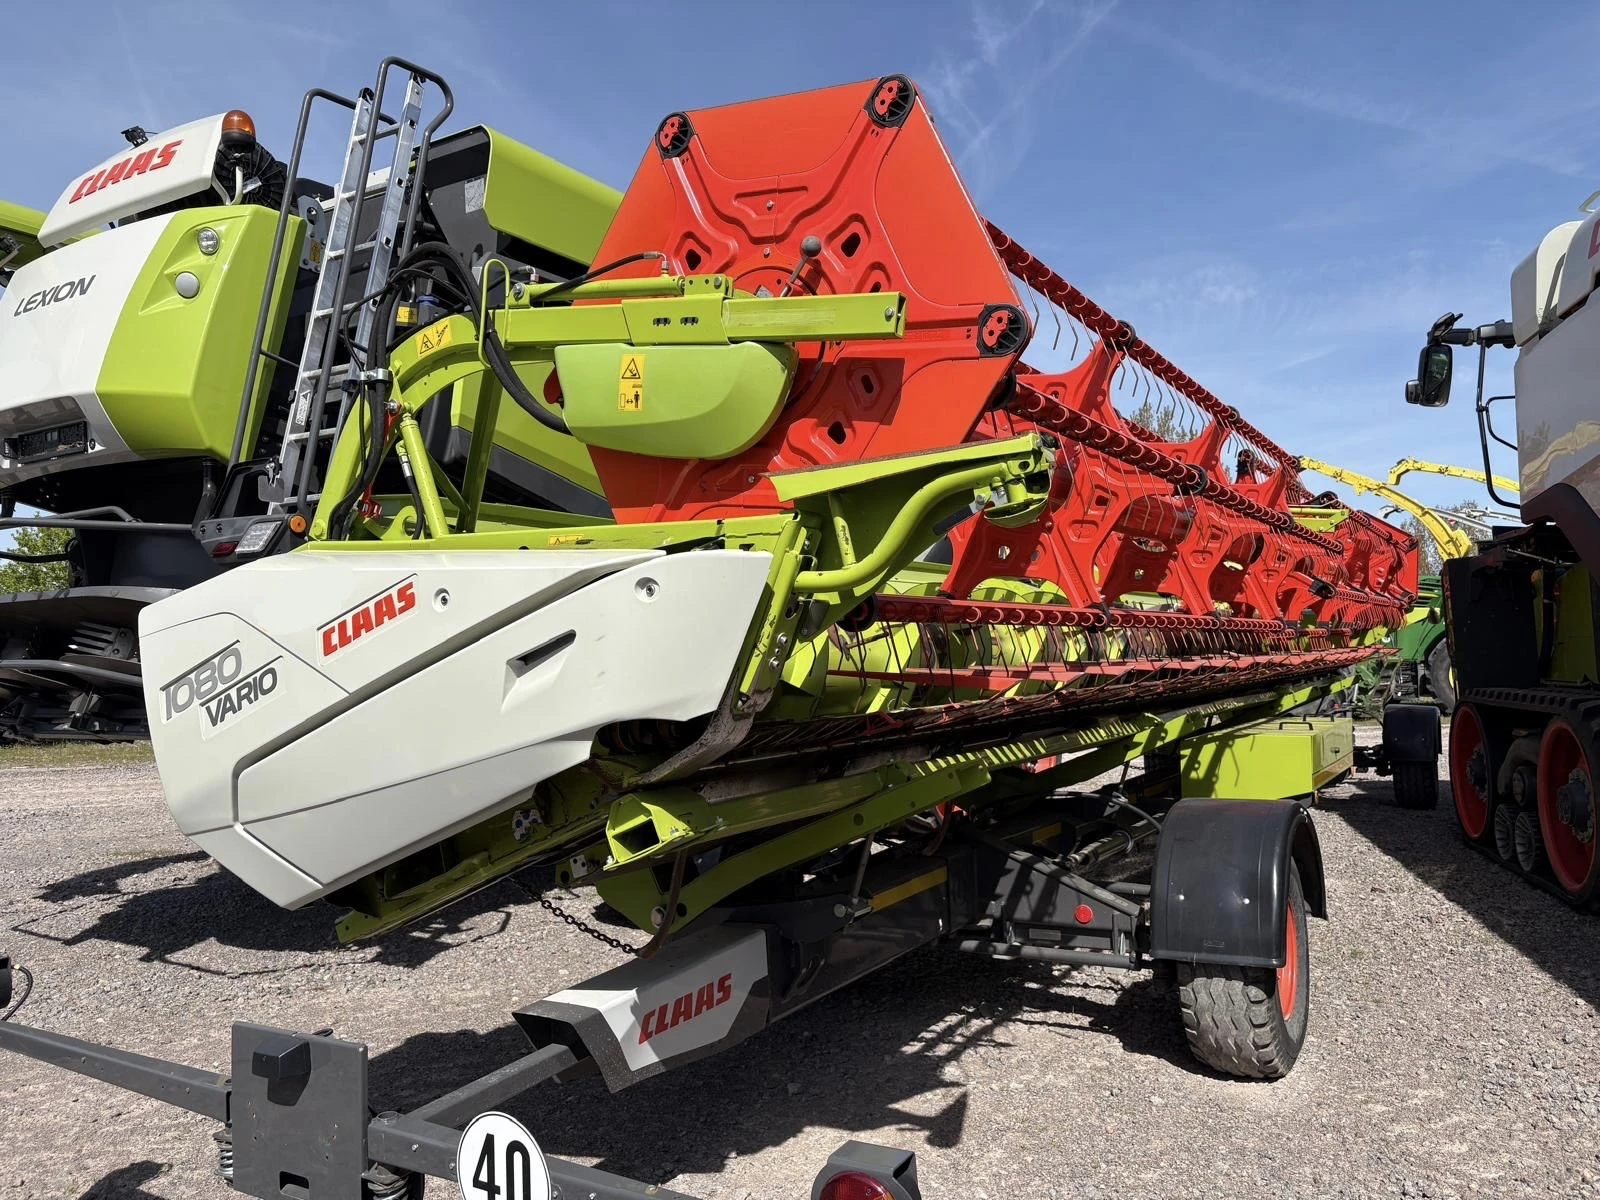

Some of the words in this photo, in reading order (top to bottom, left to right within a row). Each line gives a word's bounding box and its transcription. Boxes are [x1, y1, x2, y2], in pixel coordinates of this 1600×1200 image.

[69, 139, 183, 205] CLAAS
[14, 274, 96, 318] LEXION
[322, 581, 417, 657] CLAAS
[165, 647, 242, 721] 1080
[205, 667, 277, 727] VARIO
[638, 973, 732, 1045] CLAAS
[472, 1133, 531, 1200] 40
